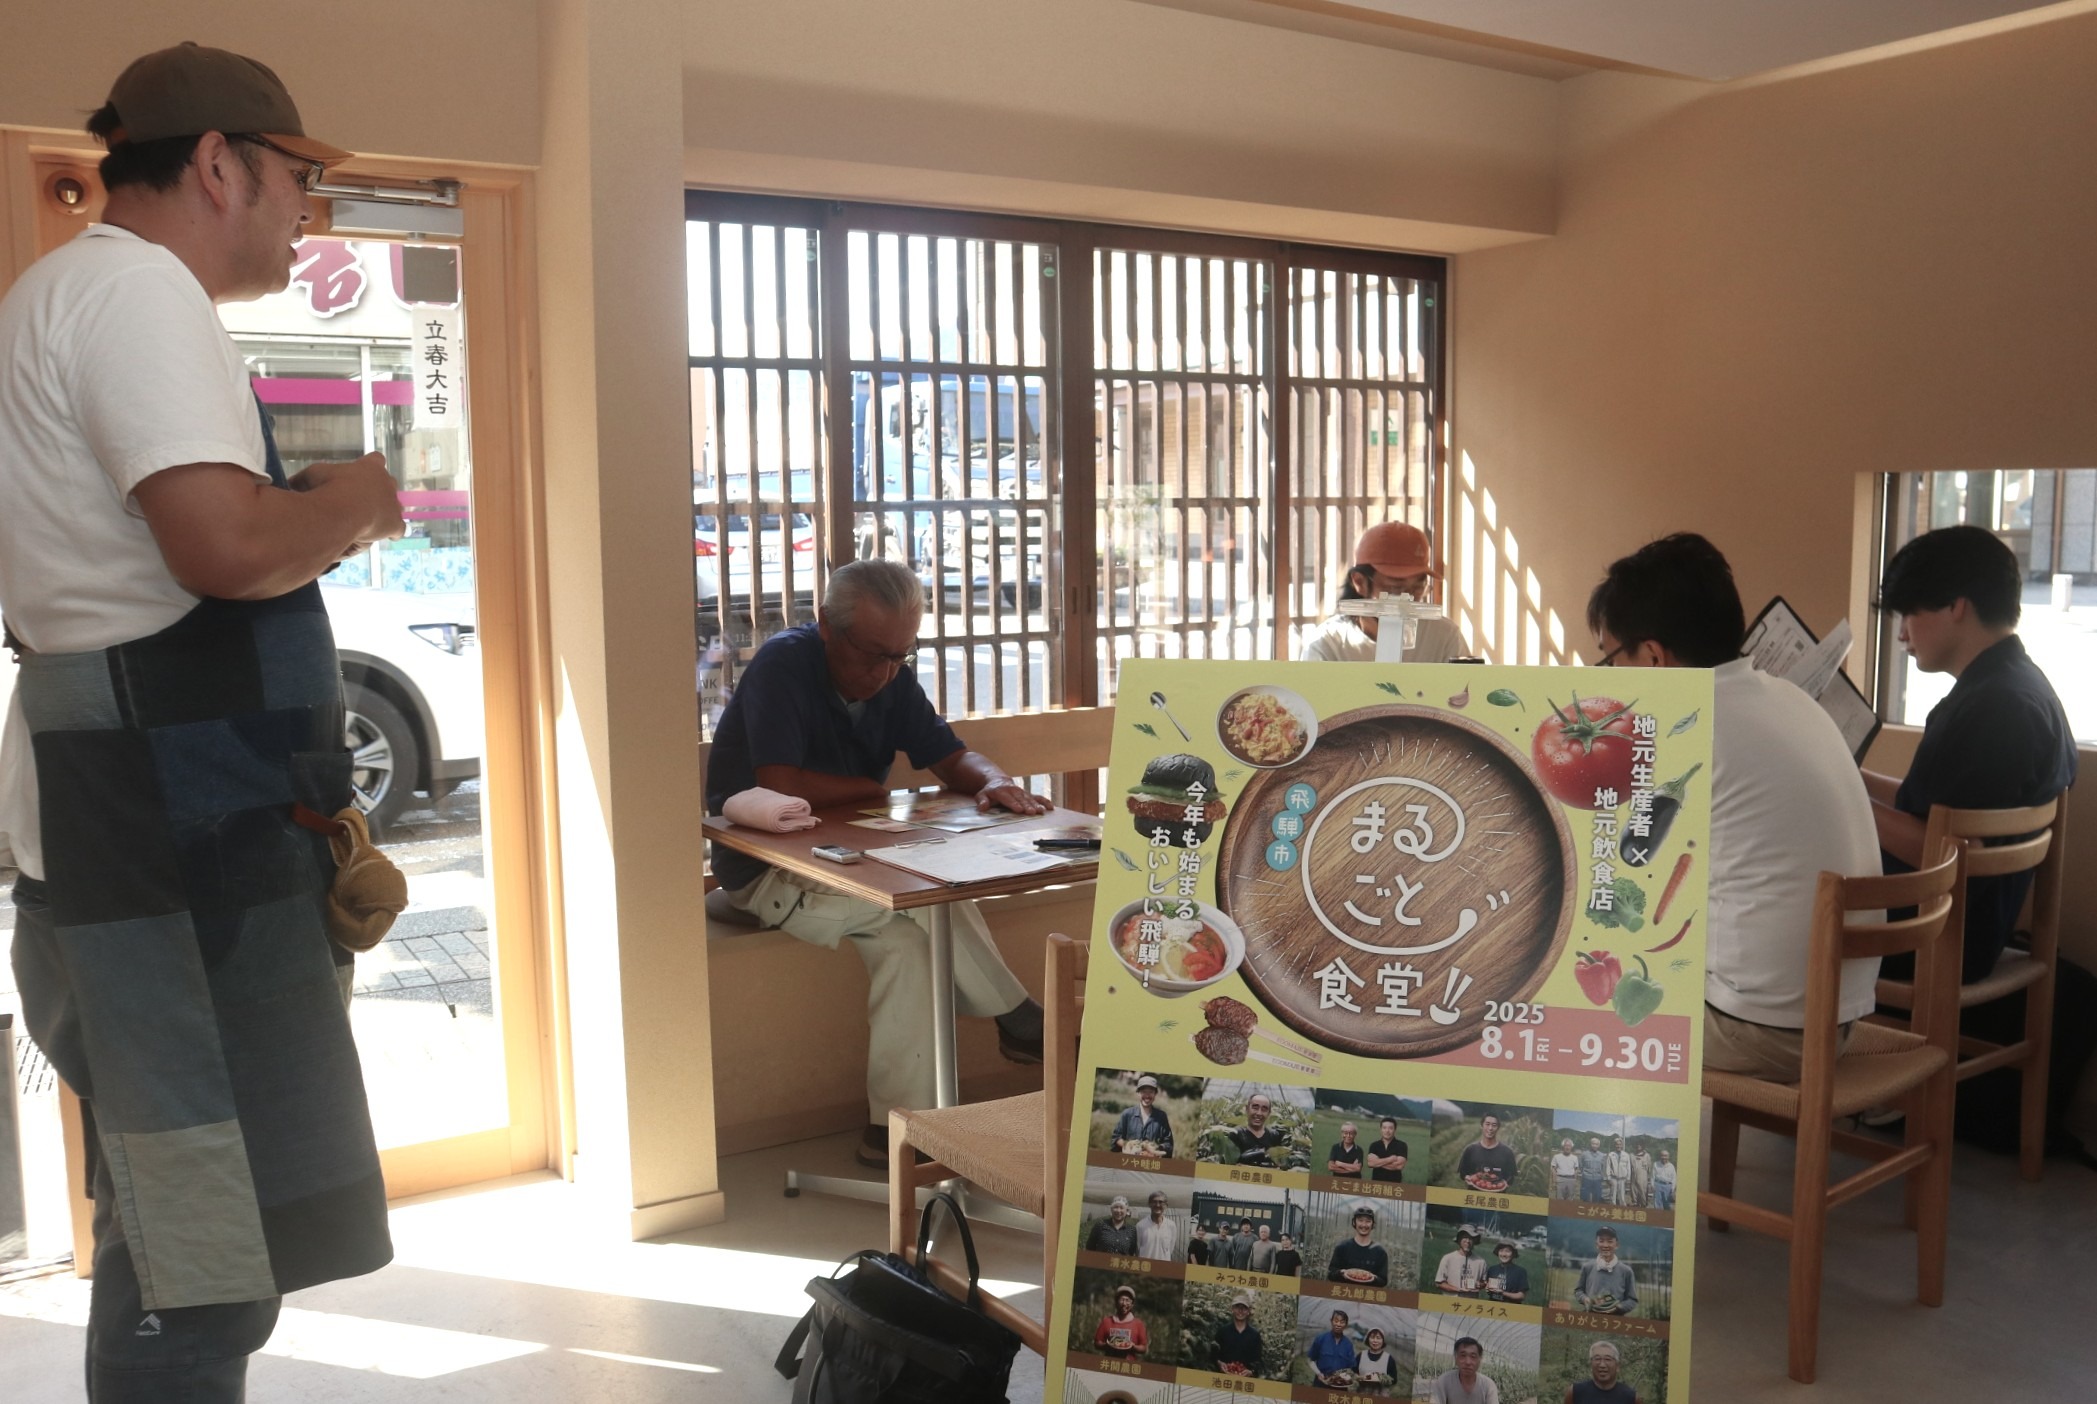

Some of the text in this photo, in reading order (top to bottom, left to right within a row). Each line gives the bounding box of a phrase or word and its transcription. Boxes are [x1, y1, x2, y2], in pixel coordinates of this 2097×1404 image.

[424, 320, 449, 414] 立春大吉
[1629, 715, 1656, 865] 地元生産者×
[1271, 787, 1313, 867] 飛騨市
[1350, 801, 1434, 854] まる
[1175, 780, 1207, 920] 今年も始まる
[1589, 787, 1618, 911] 地元飲食店
[1136, 826, 1172, 988] おいしい飛騨！
[1343, 874, 1424, 926] ごと
[1483, 1001, 1545, 1024] 2025
[1480, 1026, 1535, 1061] 8.1
[1536, 1038, 1550, 1062] FRI
[1579, 1033, 1665, 1072] 9.30
[1667, 1043, 1682, 1072] TUE
[1230, 1169, 1273, 1184] 岡田農園
[1331, 1180, 1404, 1197] えごま出荷組合
[1464, 1194, 1509, 1209] 長尾農園
[1577, 1206, 1647, 1222] こがみ養蜂園
[1109, 1257, 1152, 1272] 清水農園
[1216, 1272, 1269, 1288] みつわ農園
[1331, 1285, 1387, 1302] 長九郎農園
[1452, 1302, 1509, 1318] サノライス
[1554, 1312, 1657, 1334] ありがとうファーム
[1211, 1377, 1255, 1393] 池田農園
